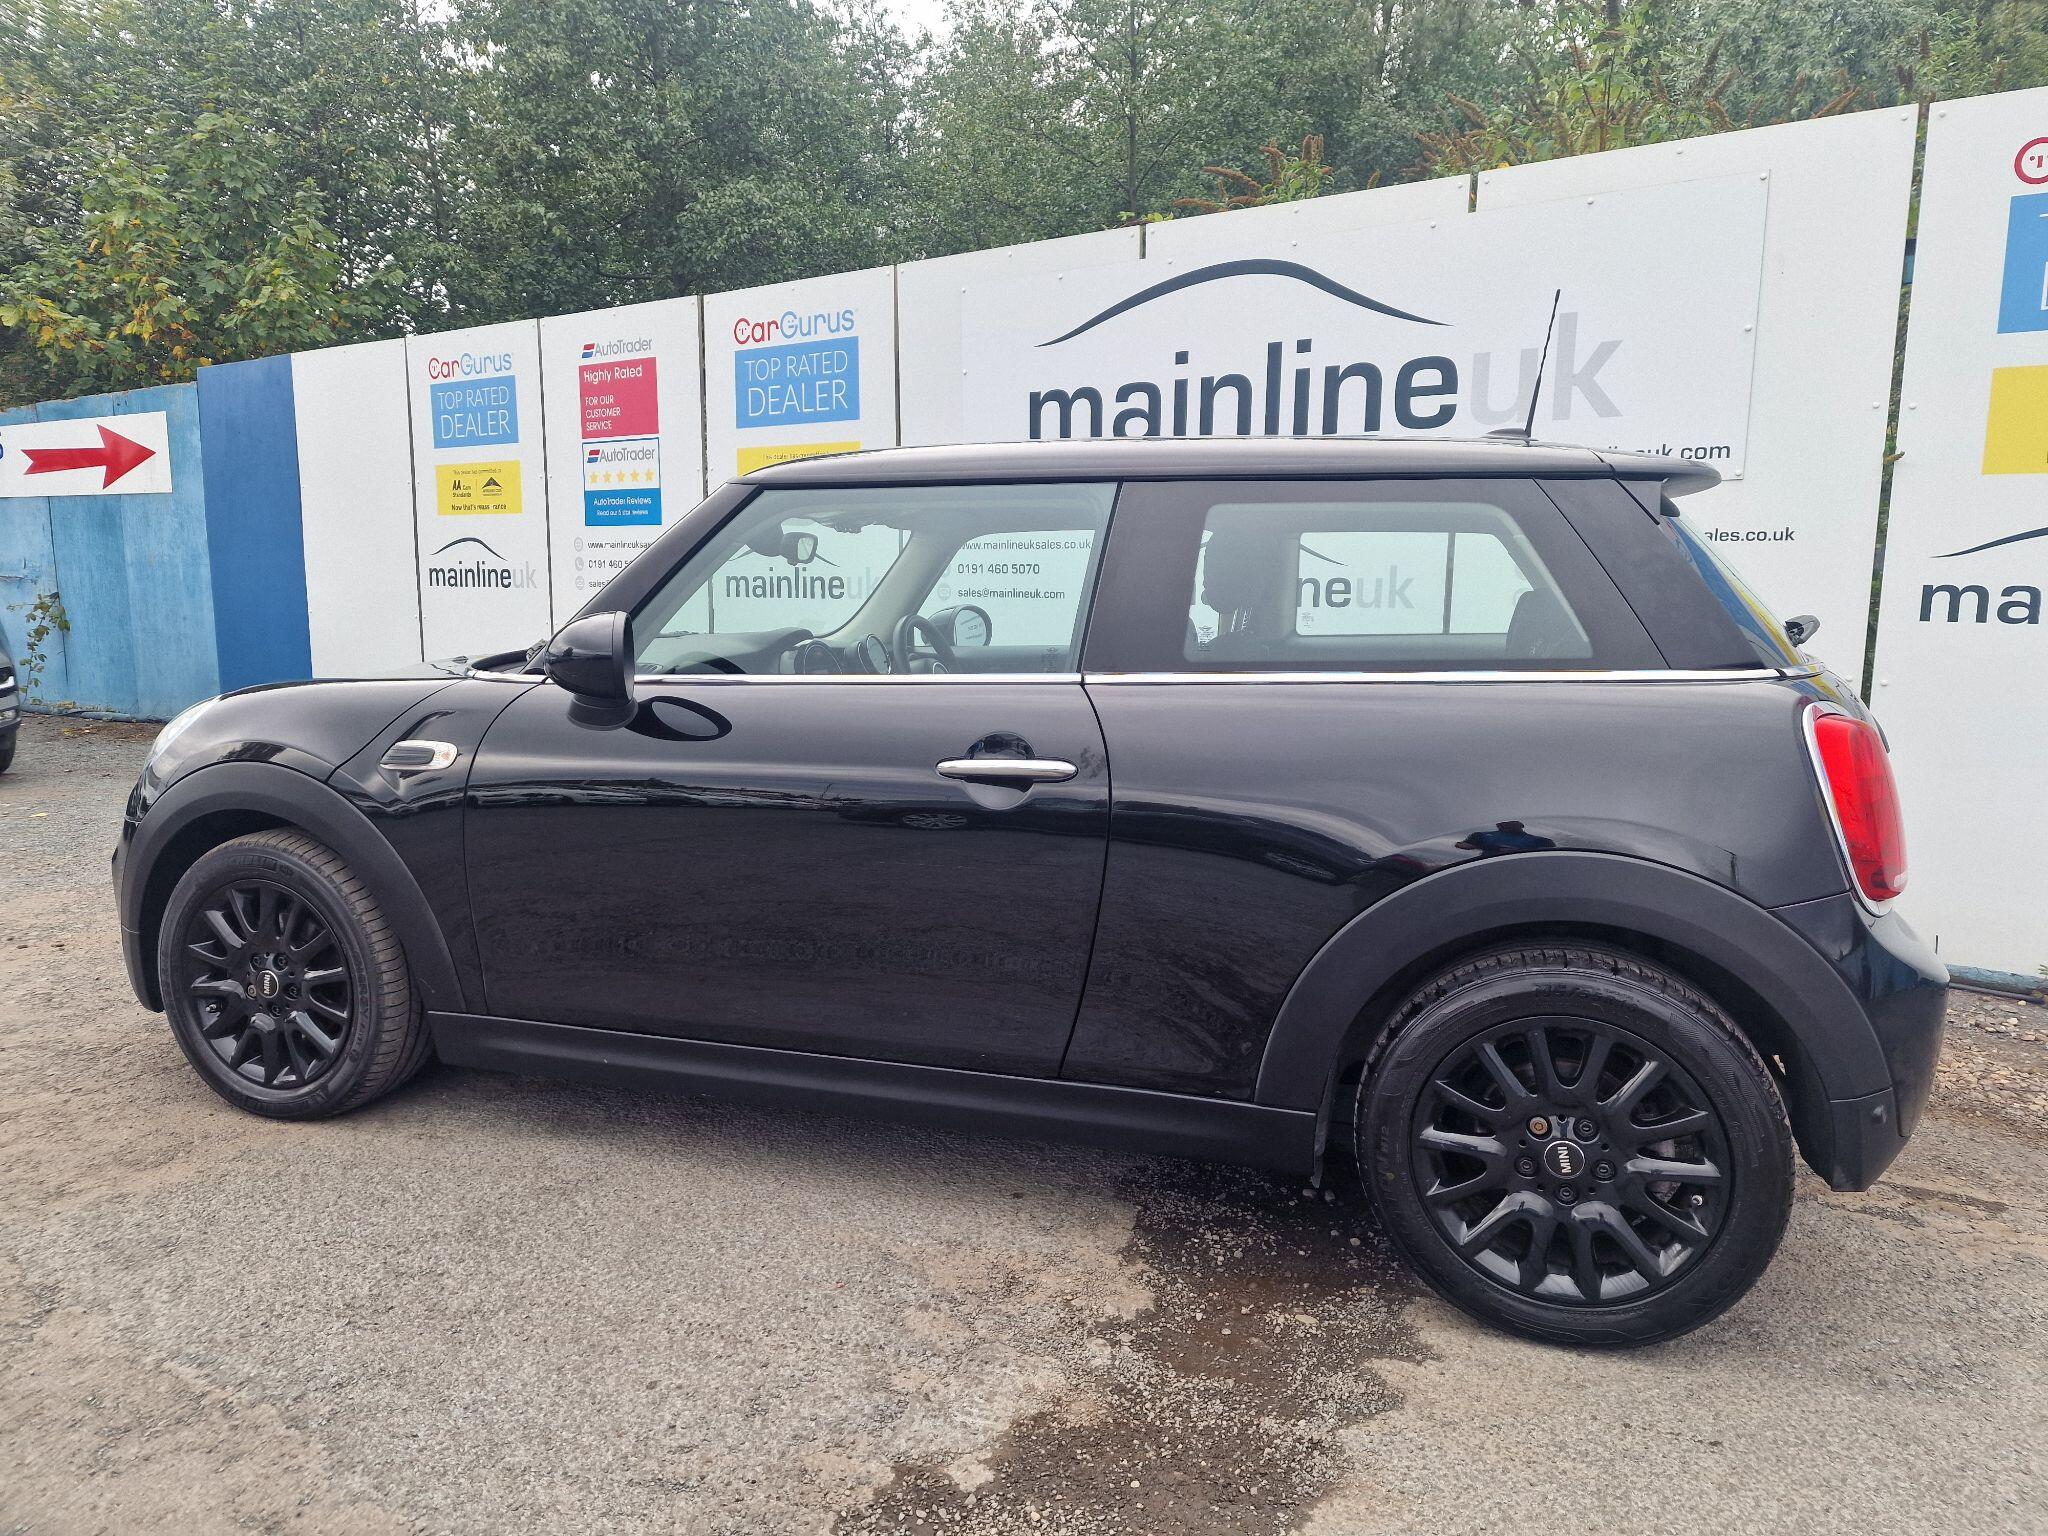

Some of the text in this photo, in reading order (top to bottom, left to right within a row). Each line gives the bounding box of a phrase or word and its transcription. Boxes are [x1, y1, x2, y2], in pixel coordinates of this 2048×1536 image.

[733, 308, 856, 346] CarGurus
[594, 337, 653, 358] AutoTrader
[428, 352, 513, 380] CarGurus
[583, 365, 643, 385] Highly Rated
[744, 350, 848, 382] TOP RATED
[1029, 311, 1624, 439] mainlineuk
[437, 386, 510, 410] TOP RATED
[585, 395, 614, 406] FOR OUR
[748, 379, 849, 417] DEALER
[585, 407, 621, 419] CUSTOMER
[440, 409, 512, 439] DEALER
[586, 420, 613, 431] SERVICE
[600, 447, 656, 463] AutoTrader
[593, 496, 652, 506] AutoTrader Reviews
[588, 559, 606, 569] 0191
[608, 559, 623, 569] 460
[957, 563, 1041, 575] 0191 460 5070
[429, 561, 538, 589] mainlineuk
[957, 588, 1066, 600] sales@mainlineuk.com
[263, 974, 271, 995] MINI
[1557, 1146, 1572, 1173] MINI
